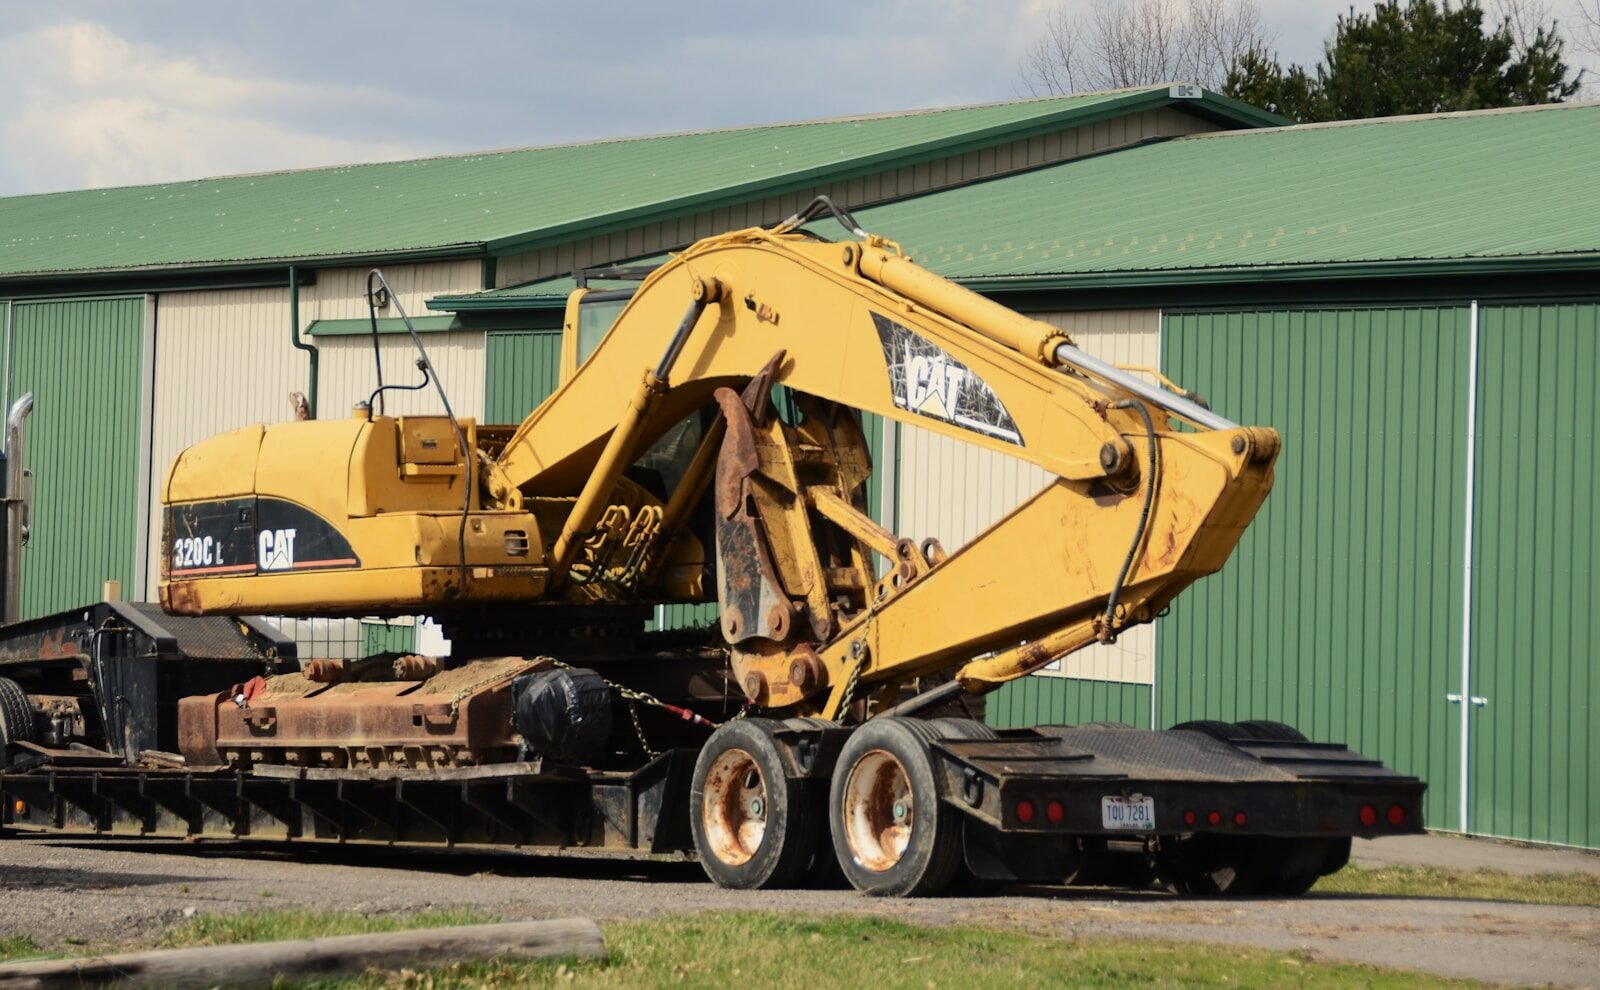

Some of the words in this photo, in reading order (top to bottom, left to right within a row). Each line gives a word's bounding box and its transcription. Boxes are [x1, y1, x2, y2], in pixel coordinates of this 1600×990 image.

[906, 355, 964, 420] CAT
[174, 536, 213, 567] 320C
[216, 541, 224, 565] L
[259, 528, 296, 570] CAT
[1127, 804, 1149, 821] 7281
